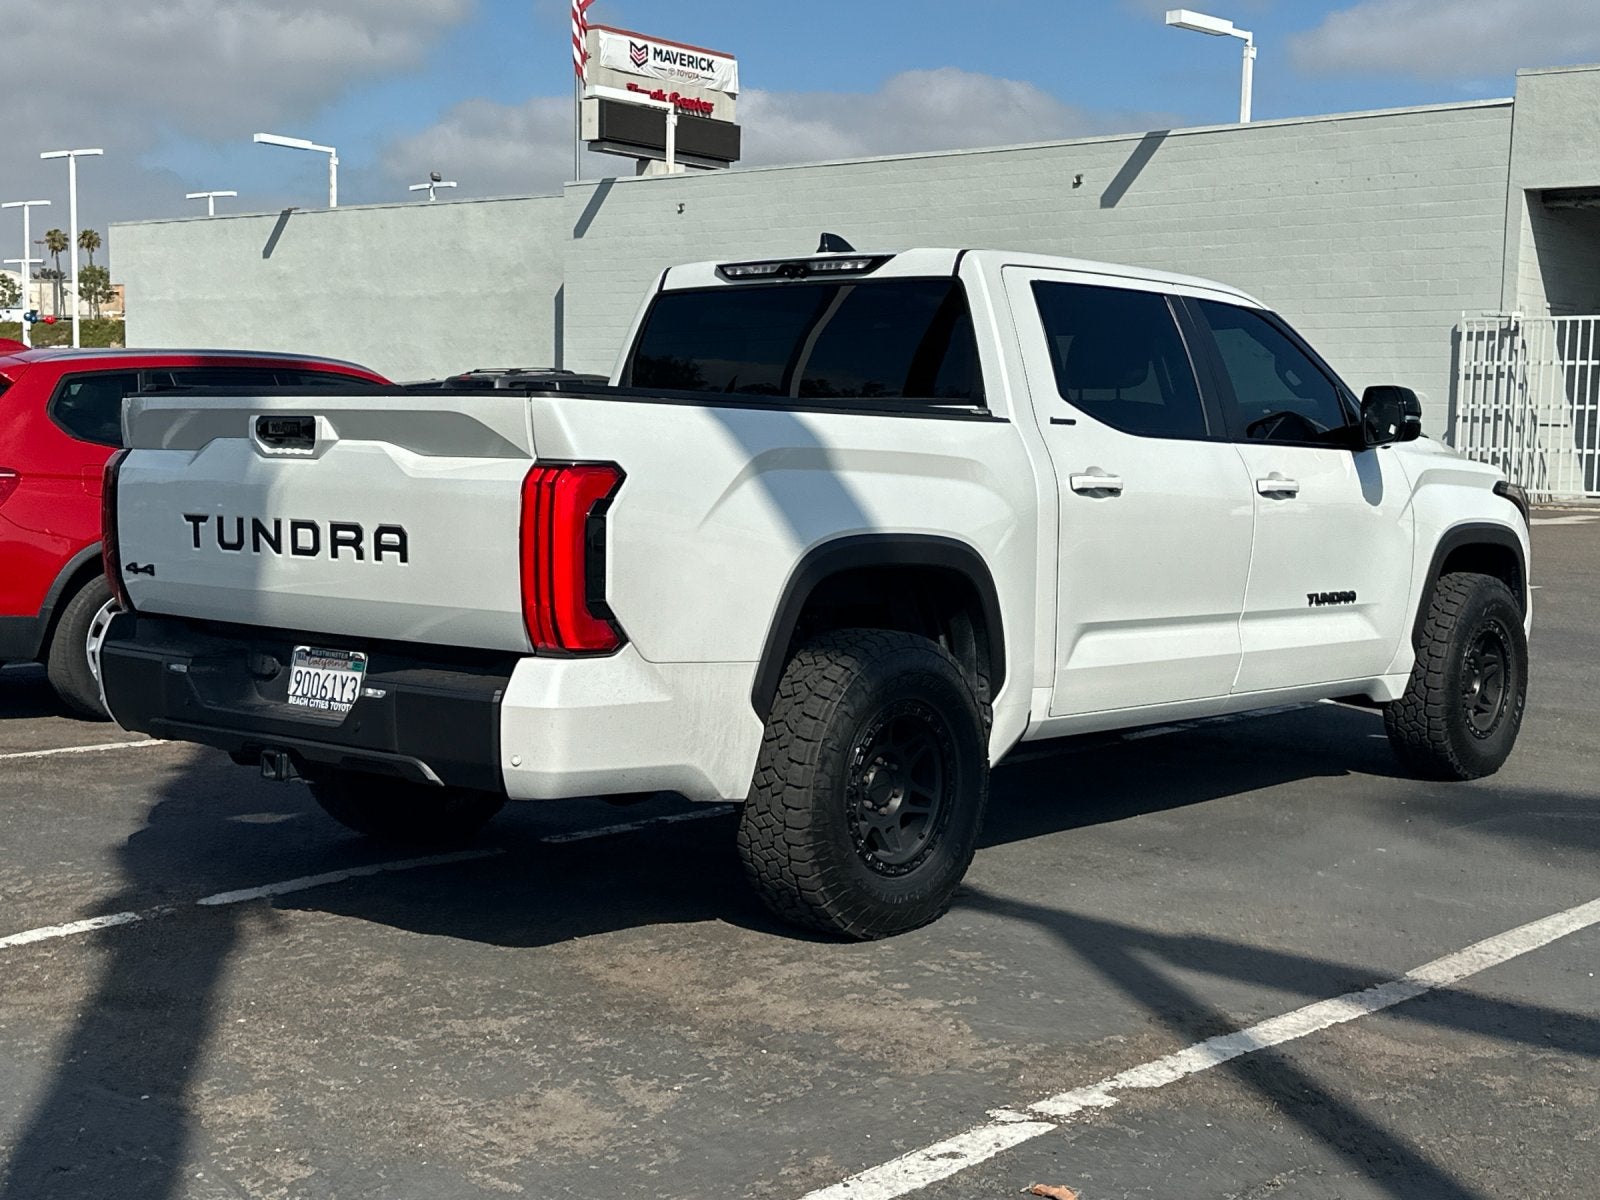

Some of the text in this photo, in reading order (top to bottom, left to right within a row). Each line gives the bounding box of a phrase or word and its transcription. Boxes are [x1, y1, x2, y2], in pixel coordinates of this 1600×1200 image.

[653, 47, 715, 72] MAVERICK
[676, 68, 700, 79] TOYOTA
[626, 83, 714, 113] Tck Center
[182, 513, 409, 565] TUNDRA
[1307, 591, 1356, 607] TUNDRA
[292, 670, 358, 703] 90061Y3
[288, 696, 308, 707] BEACH
[309, 699, 328, 709] CITIES
